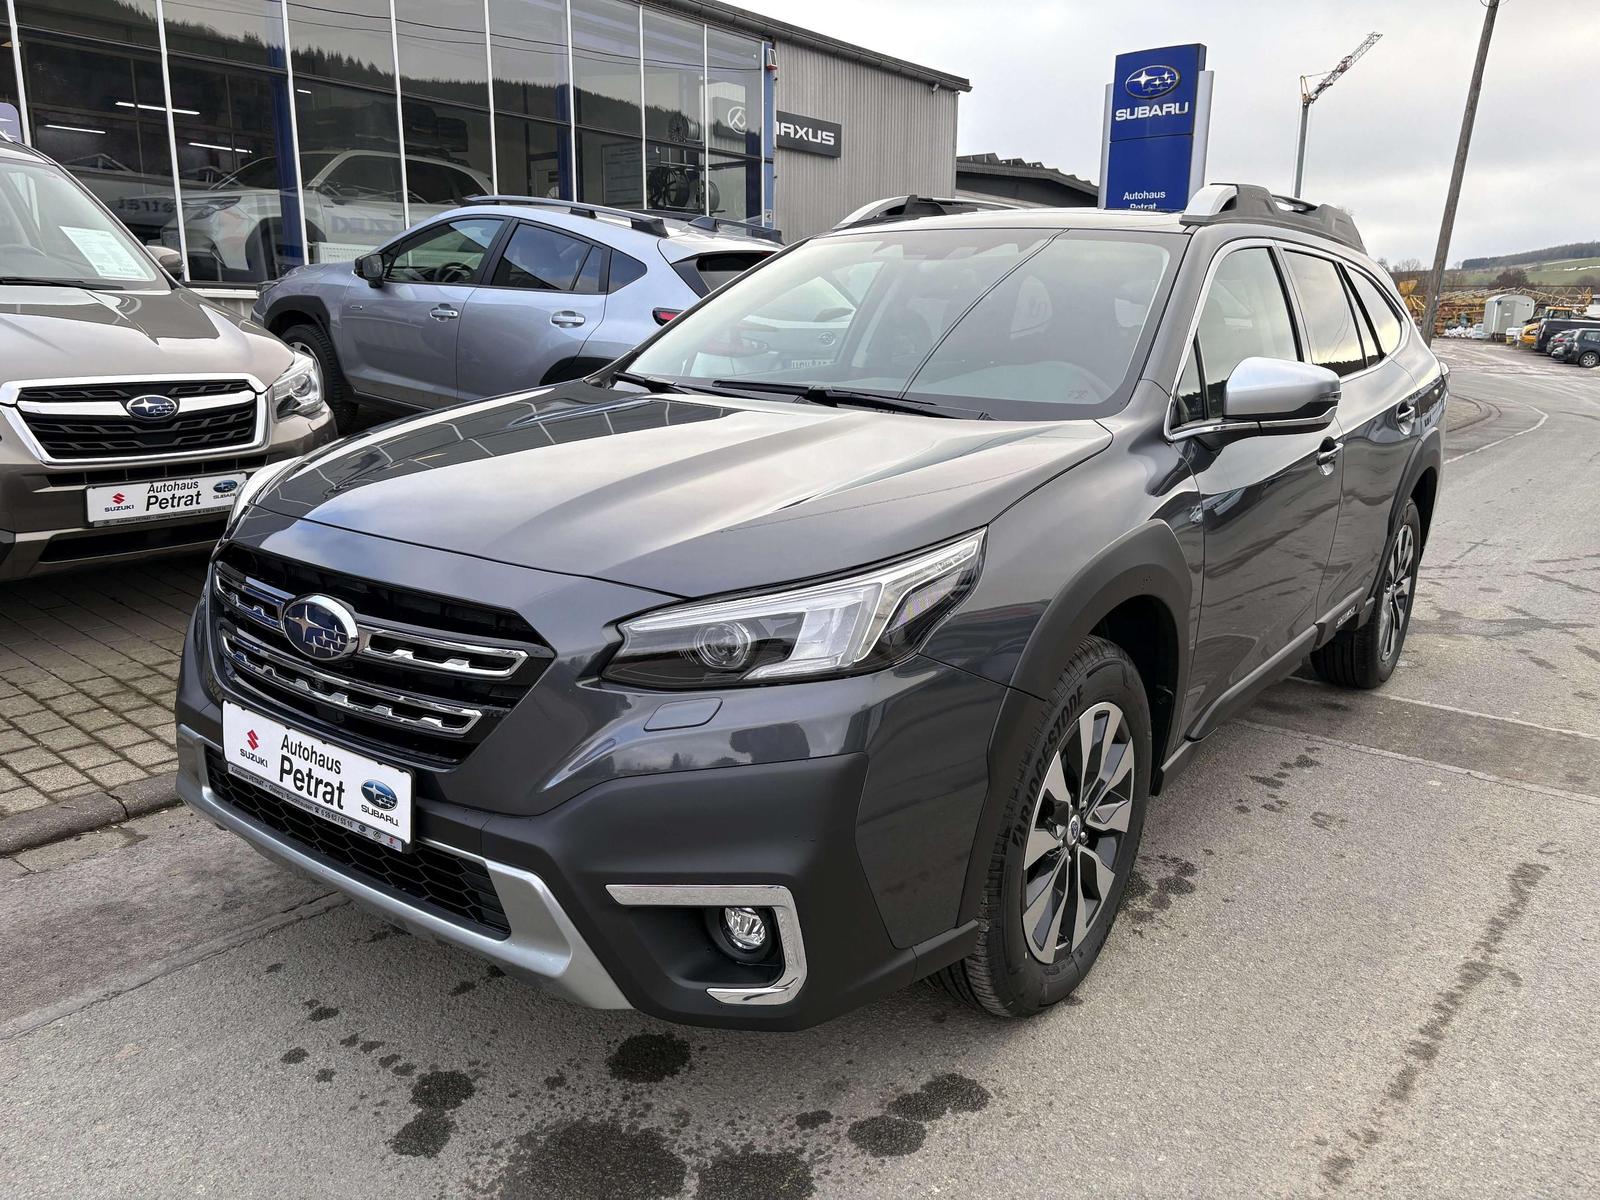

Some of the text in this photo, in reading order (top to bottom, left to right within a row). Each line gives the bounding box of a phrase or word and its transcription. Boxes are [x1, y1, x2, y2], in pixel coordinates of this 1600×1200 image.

[1115, 102, 1189, 121] SUBARU
[1123, 190, 1166, 201] Autohaus
[147, 481, 199, 495] Autohaus
[104, 504, 135, 512] SUZUKI
[145, 492, 202, 512] Petrat
[239, 748, 268, 768] SUZUKI
[280, 734, 342, 775] Autohaus
[1012, 684, 1084, 849] BRIDGESTONE
[279, 754, 345, 810] Petrat
[360, 804, 400, 827] SUBARU
